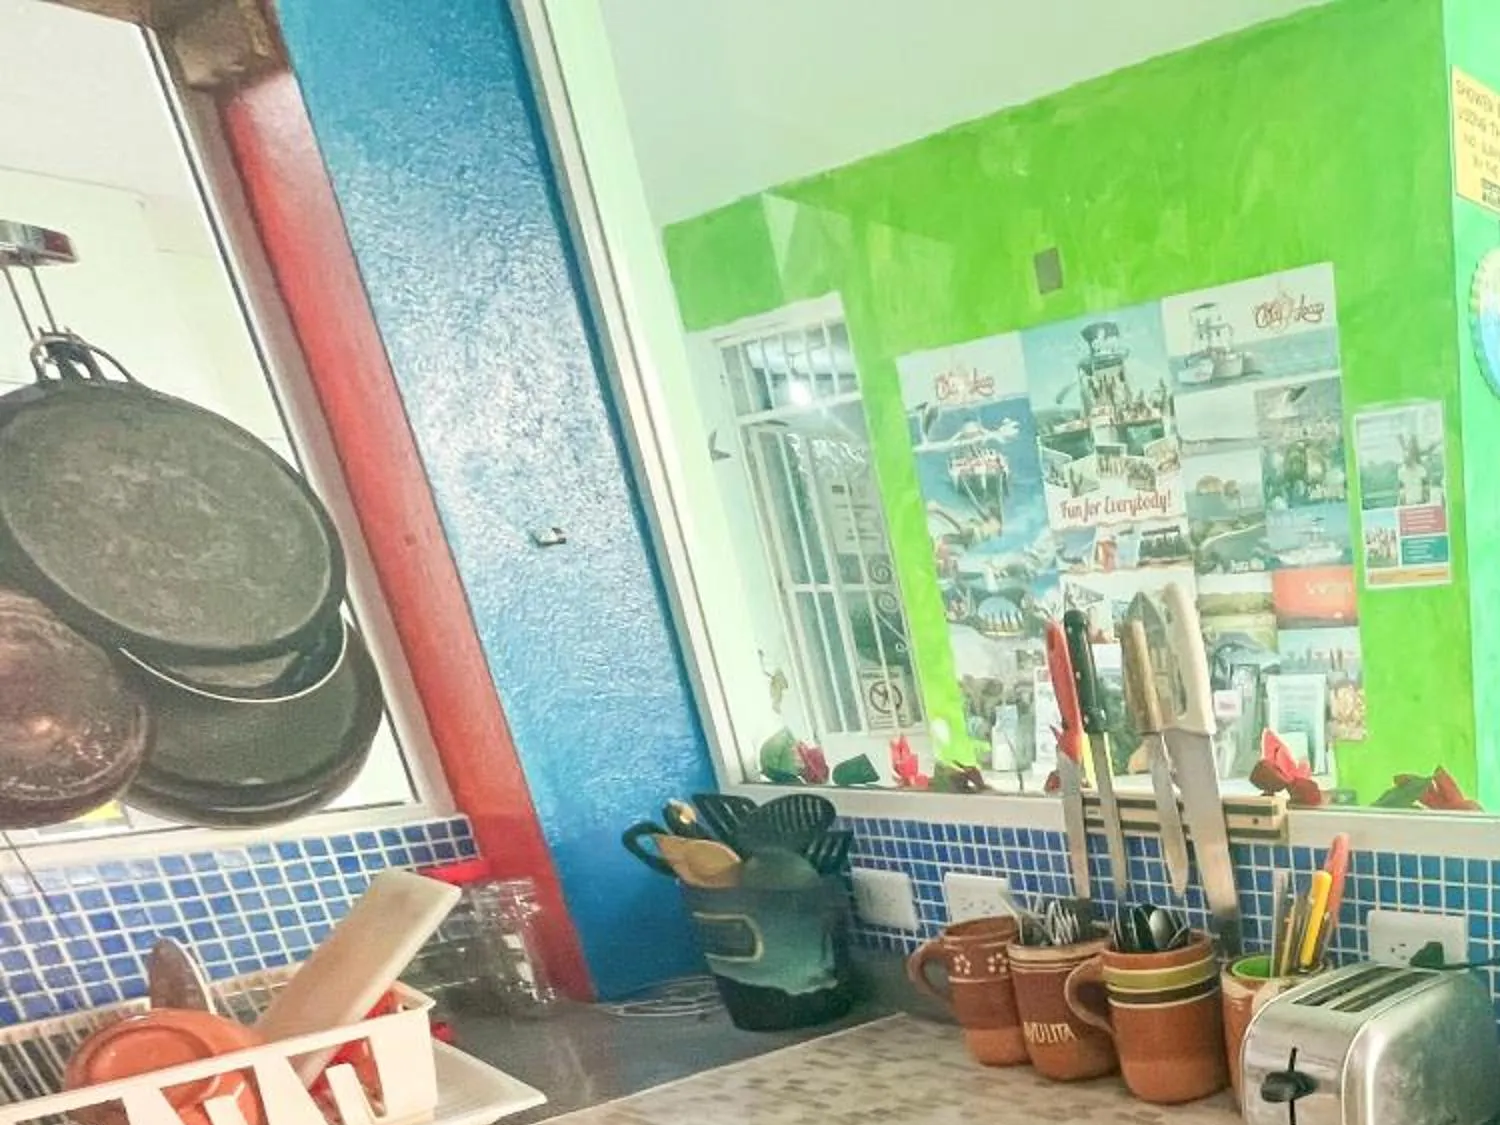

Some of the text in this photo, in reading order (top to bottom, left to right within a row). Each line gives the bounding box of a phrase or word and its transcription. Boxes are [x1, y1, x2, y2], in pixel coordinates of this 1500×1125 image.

[1060, 489, 1171, 522] Fun for Everybody!
